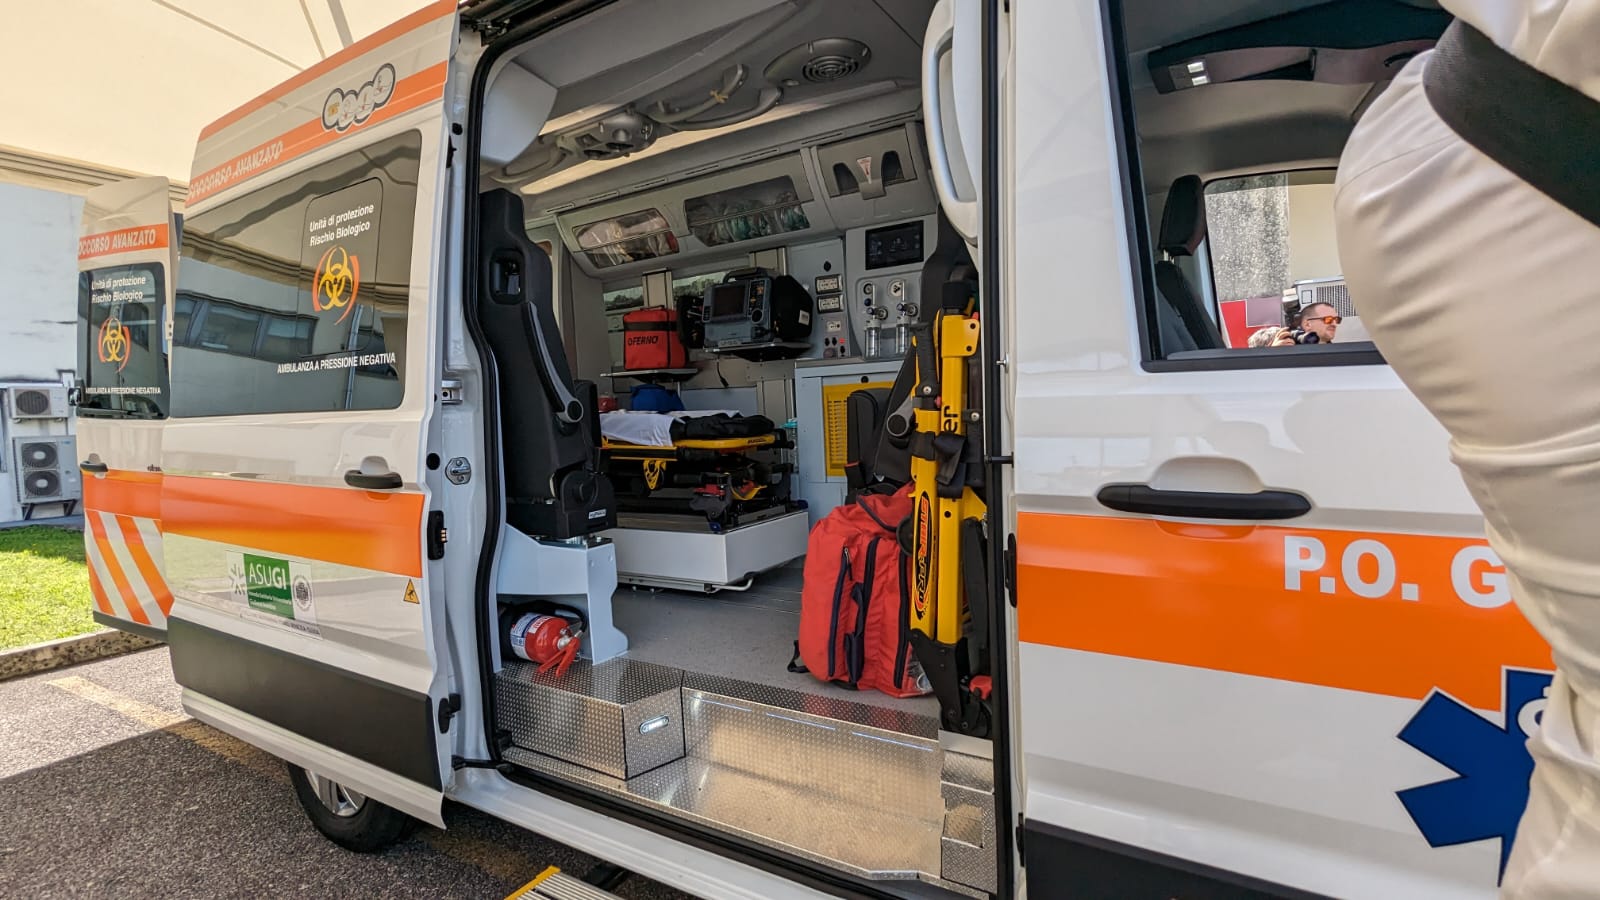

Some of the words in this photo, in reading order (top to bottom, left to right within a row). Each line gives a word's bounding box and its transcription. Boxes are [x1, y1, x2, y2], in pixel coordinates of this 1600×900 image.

[231, 140, 284, 180] AVANZATO
[328, 214, 335, 226] di
[336, 204, 375, 226] protezione
[112, 229, 156, 250] AVANZATO
[310, 230, 335, 247] Rischio
[336, 221, 371, 239] Biologico
[277, 361, 313, 374] AMBULANZA
[313, 361, 319, 371] A
[320, 356, 358, 370] PRESSIONE
[360, 352, 396, 367] NEGATIVA
[248, 562, 287, 590] ASUGI
[1284, 535, 1419, 602] P.O.
